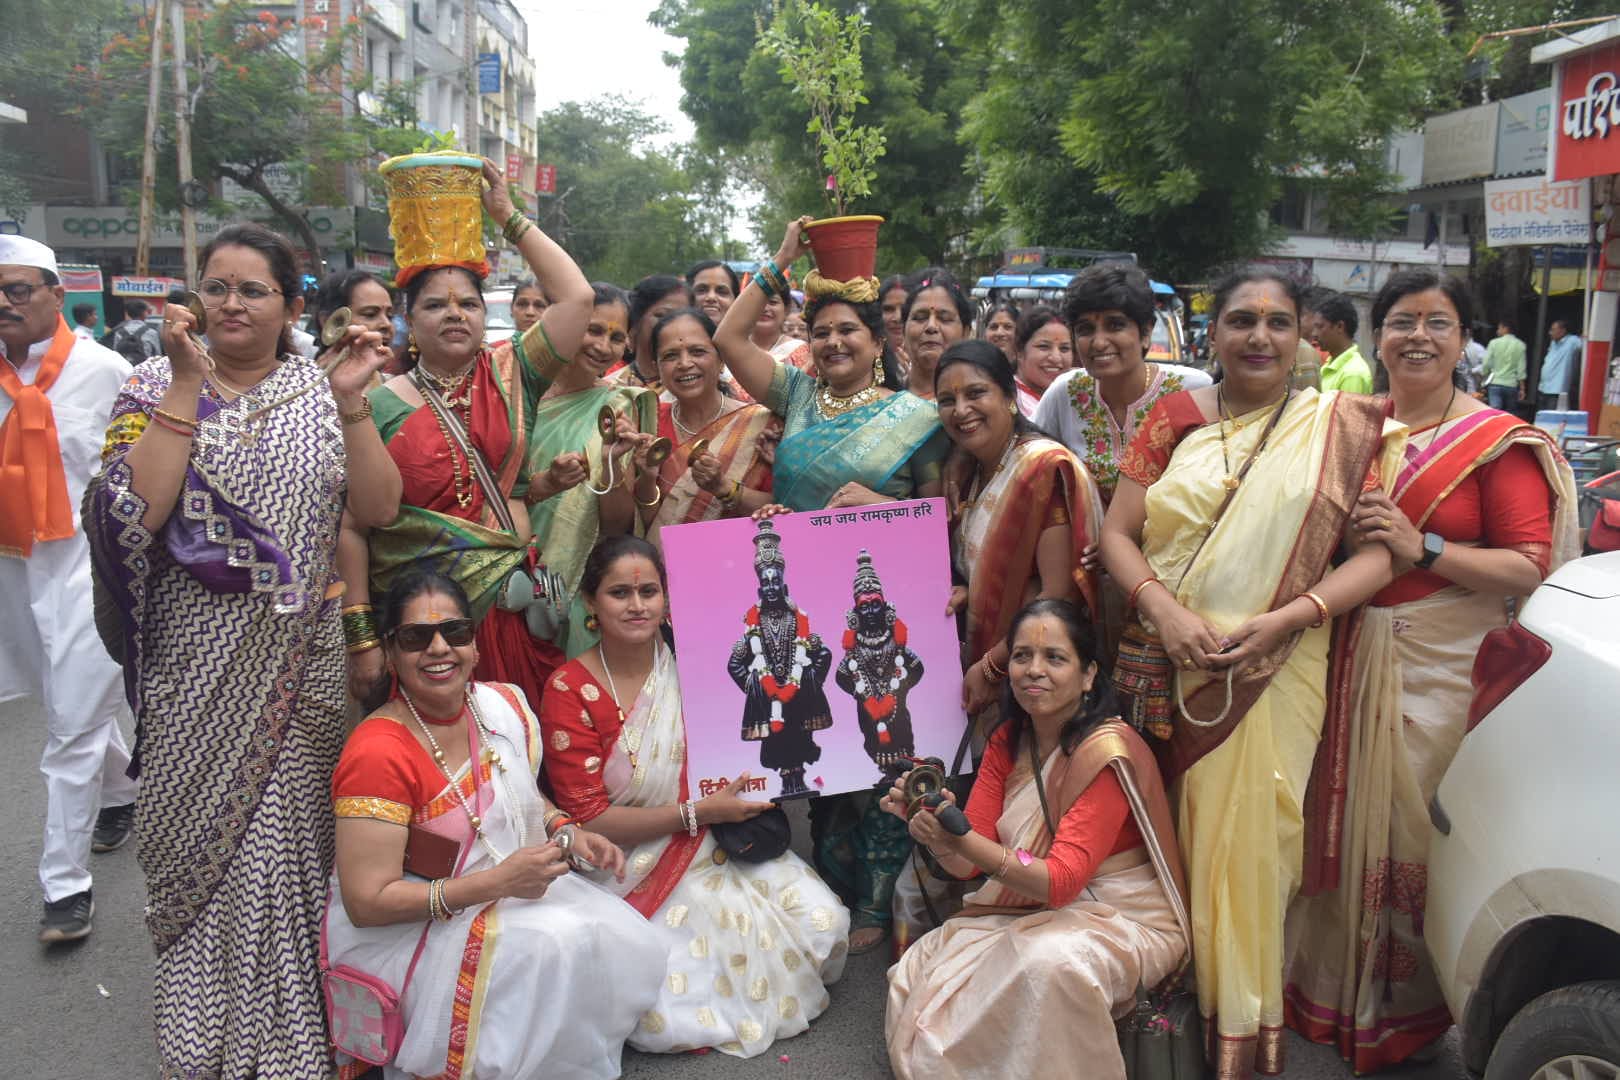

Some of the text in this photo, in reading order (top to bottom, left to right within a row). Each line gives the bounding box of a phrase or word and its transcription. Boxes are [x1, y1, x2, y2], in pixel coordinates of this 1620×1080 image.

[810, 502, 932, 527] जय जय रामकृष्ण हरि
